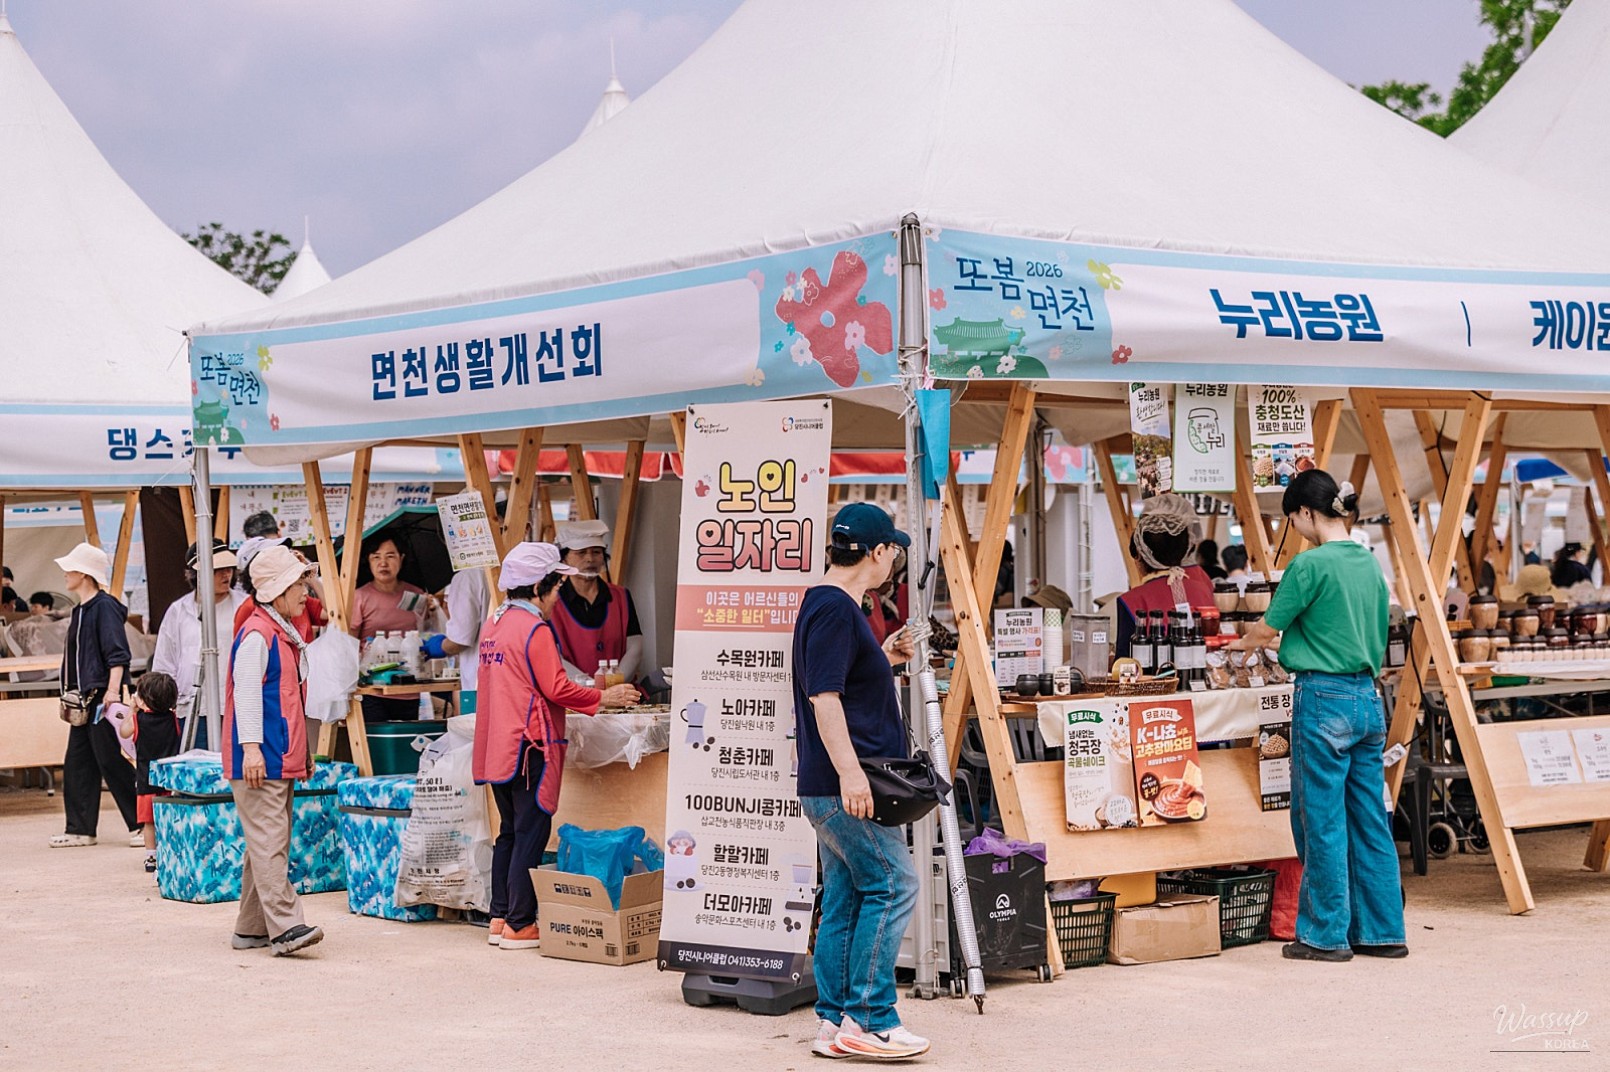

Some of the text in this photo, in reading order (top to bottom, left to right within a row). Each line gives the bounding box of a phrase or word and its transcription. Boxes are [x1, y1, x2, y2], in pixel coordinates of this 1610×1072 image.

[954, 256, 1063, 300] 또봄 2026
[1027, 285, 1095, 331] 면천
[1209, 288, 1384, 342] 누리농원
[200, 352, 231, 386] 또봄
[371, 322, 602, 401] 면천생활개선회
[229, 370, 260, 406] 면천
[1138, 388, 1160, 402] 누리농원
[1185, 384, 1228, 397] 누리농원
[1262, 389, 1297, 404] 100%
[1255, 404, 1305, 420] 충청도산
[1257, 421, 1306, 432] 재료만 씁니다!
[1206, 432, 1225, 450] 누리
[716, 458, 796, 513] 노인
[696, 517, 813, 572] 일자리
[706, 591, 799, 607] 이곳은 어르신들의
[1006, 618, 1032, 626] 누리농원
[716, 649, 784, 668] 수목원카페
[701, 671, 743, 682] 삼선산수목원
[744, 672, 751, 681] 내
[752, 673, 787, 683] 방문자센터
[721, 698, 776, 717] 노아카페
[1261, 694, 1291, 710] 전통 장
[1071, 712, 1096, 721] 무료시식
[1146, 709, 1173, 720] 무료시식
[756, 721, 764, 730] 내
[765, 721, 775, 732] 1층
[1068, 729, 1095, 739] 냄새없는
[1136, 723, 1177, 744] K-나쵸
[1068, 738, 1102, 756] 청국장
[1135, 736, 1193, 758] 고추장마요딥
[718, 747, 774, 766] 청춘카페
[711, 767, 780, 781] 당진시립도서관 내 1층
[685, 794, 802, 818] 100BUNJI콩카페
[701, 816, 785, 832] 삽교천농식품직판장 내 3층
[714, 844, 769, 866] 할할카페
[701, 865, 780, 881] 당진2동행정복지센터 1층
[703, 893, 773, 916] 더모아카페
[989, 908, 1017, 919] OLYMPIA
[550, 922, 571, 934] PURE
[573, 925, 604, 940] 아이스팩
[695, 914, 776, 931] 송악문화스포츠센터 내 1층
[677, 949, 784, 970] 당진시니어클럽 041)353-6188
